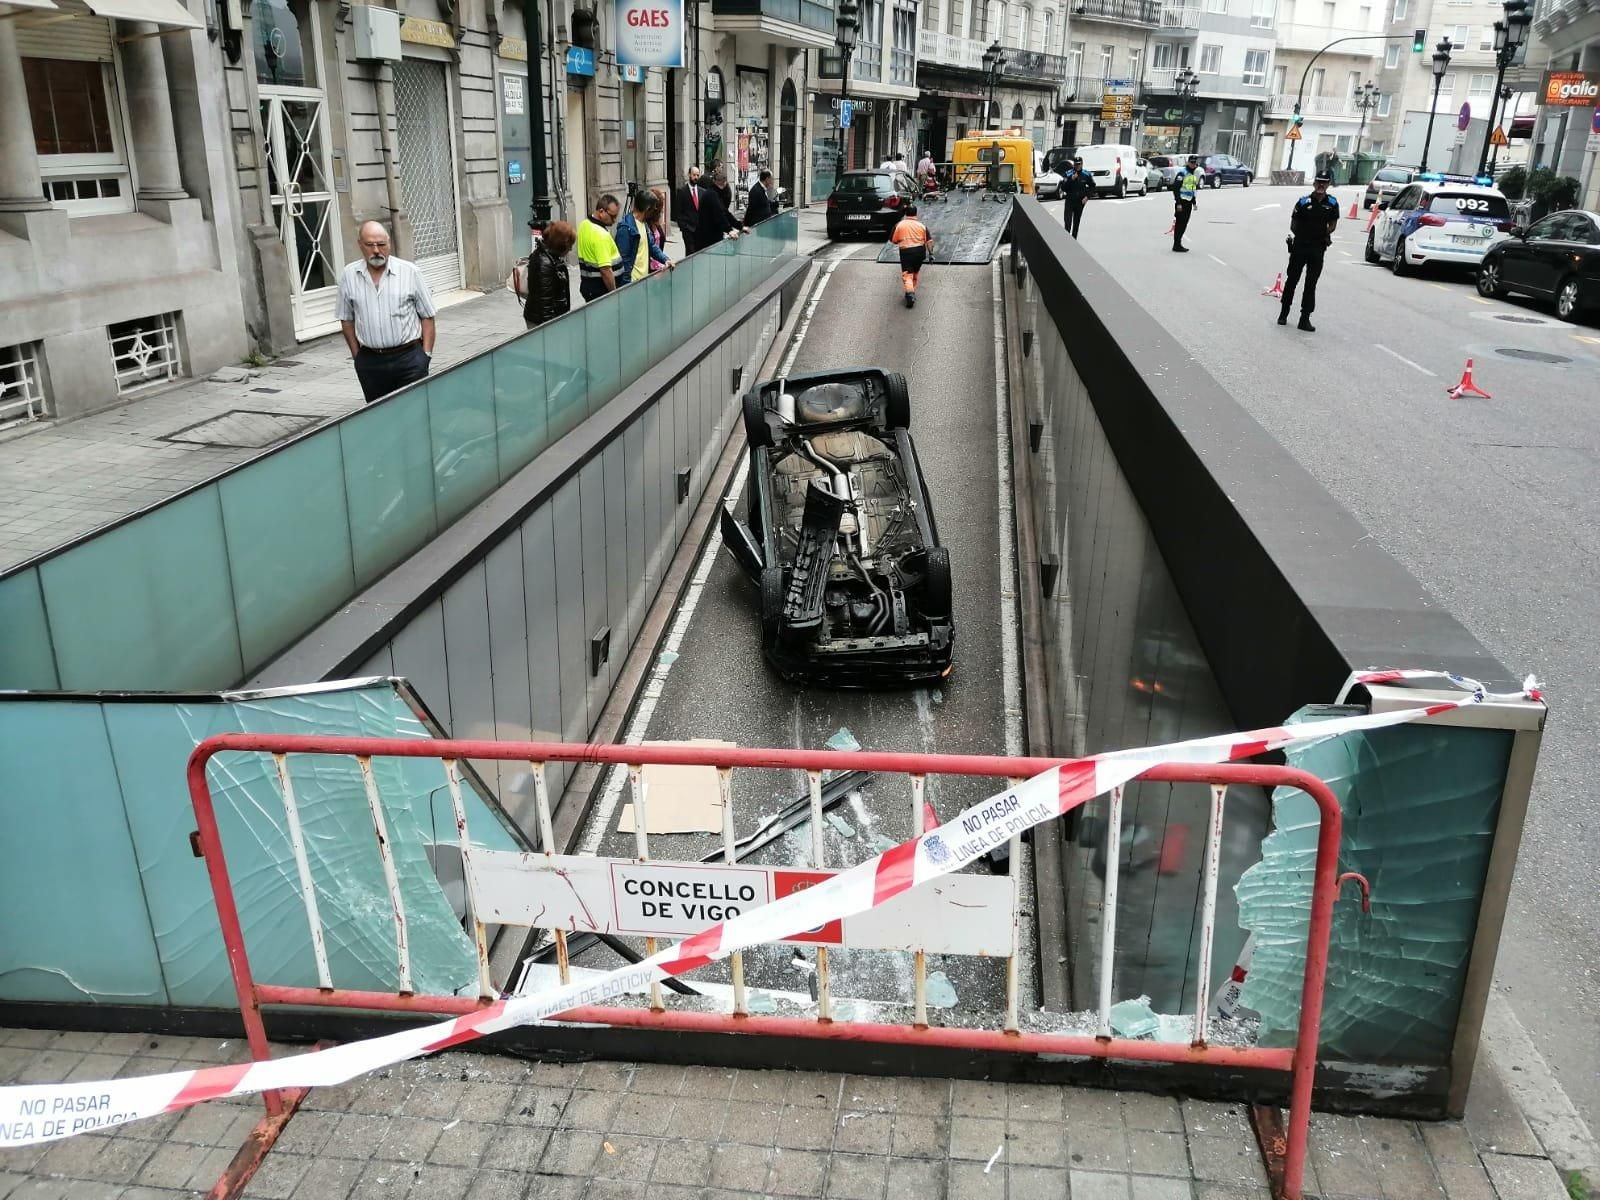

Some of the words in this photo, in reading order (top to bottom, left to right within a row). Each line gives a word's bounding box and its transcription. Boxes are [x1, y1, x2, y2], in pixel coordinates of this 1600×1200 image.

[627, 9, 669, 27] GAES
[274, 33, 281, 54] 7
[1560, 80, 1598, 98] galia
[1455, 198, 1489, 212] 092
[962, 815, 982, 835] NO
[982, 795, 1021, 824] PASAR
[953, 837, 989, 862] LINEA
[988, 826, 1005, 843] DE
[1005, 803, 1052, 833] POLICIA
[624, 879, 755, 902] CONCELLO
[641, 901, 673, 919] DE
[681, 903, 741, 921] VIGO
[20, 1099, 46, 1116] NO
[52, 1094, 111, 1114] PASAR
[42, 1119, 66, 1137] DE
